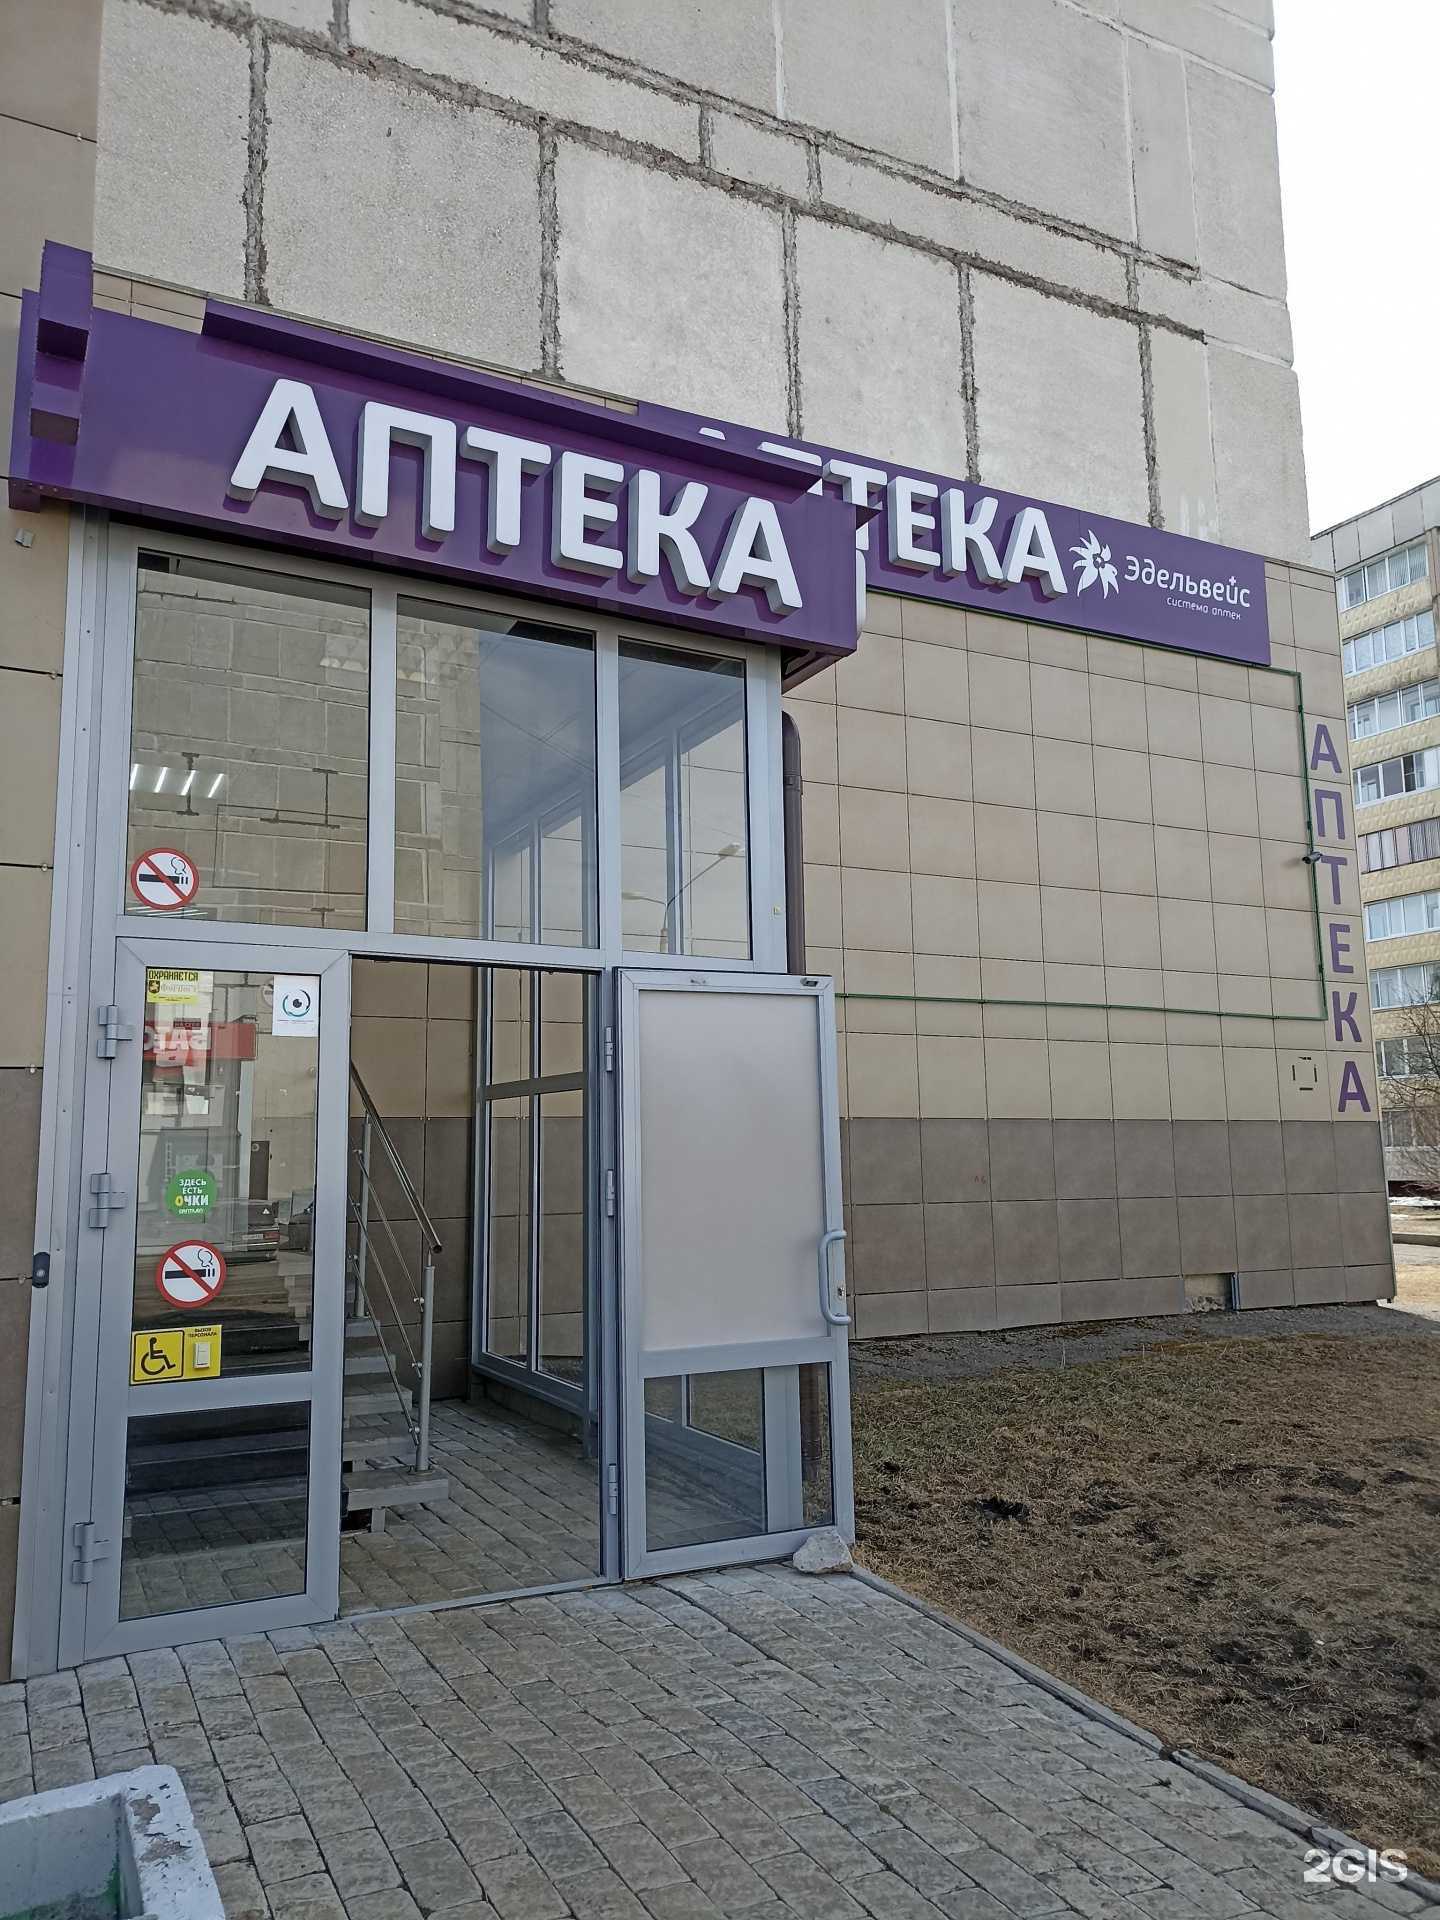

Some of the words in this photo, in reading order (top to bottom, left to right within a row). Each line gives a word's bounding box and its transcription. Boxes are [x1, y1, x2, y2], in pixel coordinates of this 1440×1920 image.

[228, 378, 804, 615] АПТЕКА
[698, 427, 1069, 597] ТЕКА
[1124, 555, 1251, 608] Эдельвейс
[1166, 597, 1208, 613] система
[1212, 607, 1241, 620] аптек
[1310, 723, 1372, 1113] АПТЕКА
[149, 970, 198, 981] ОХРАНЯЕТСЯ
[179, 1178, 207, 1187] ЗДЕСЬ
[182, 1187, 203, 1195] ЕСТЬ
[175, 1194, 209, 1207] ОЧКИ
